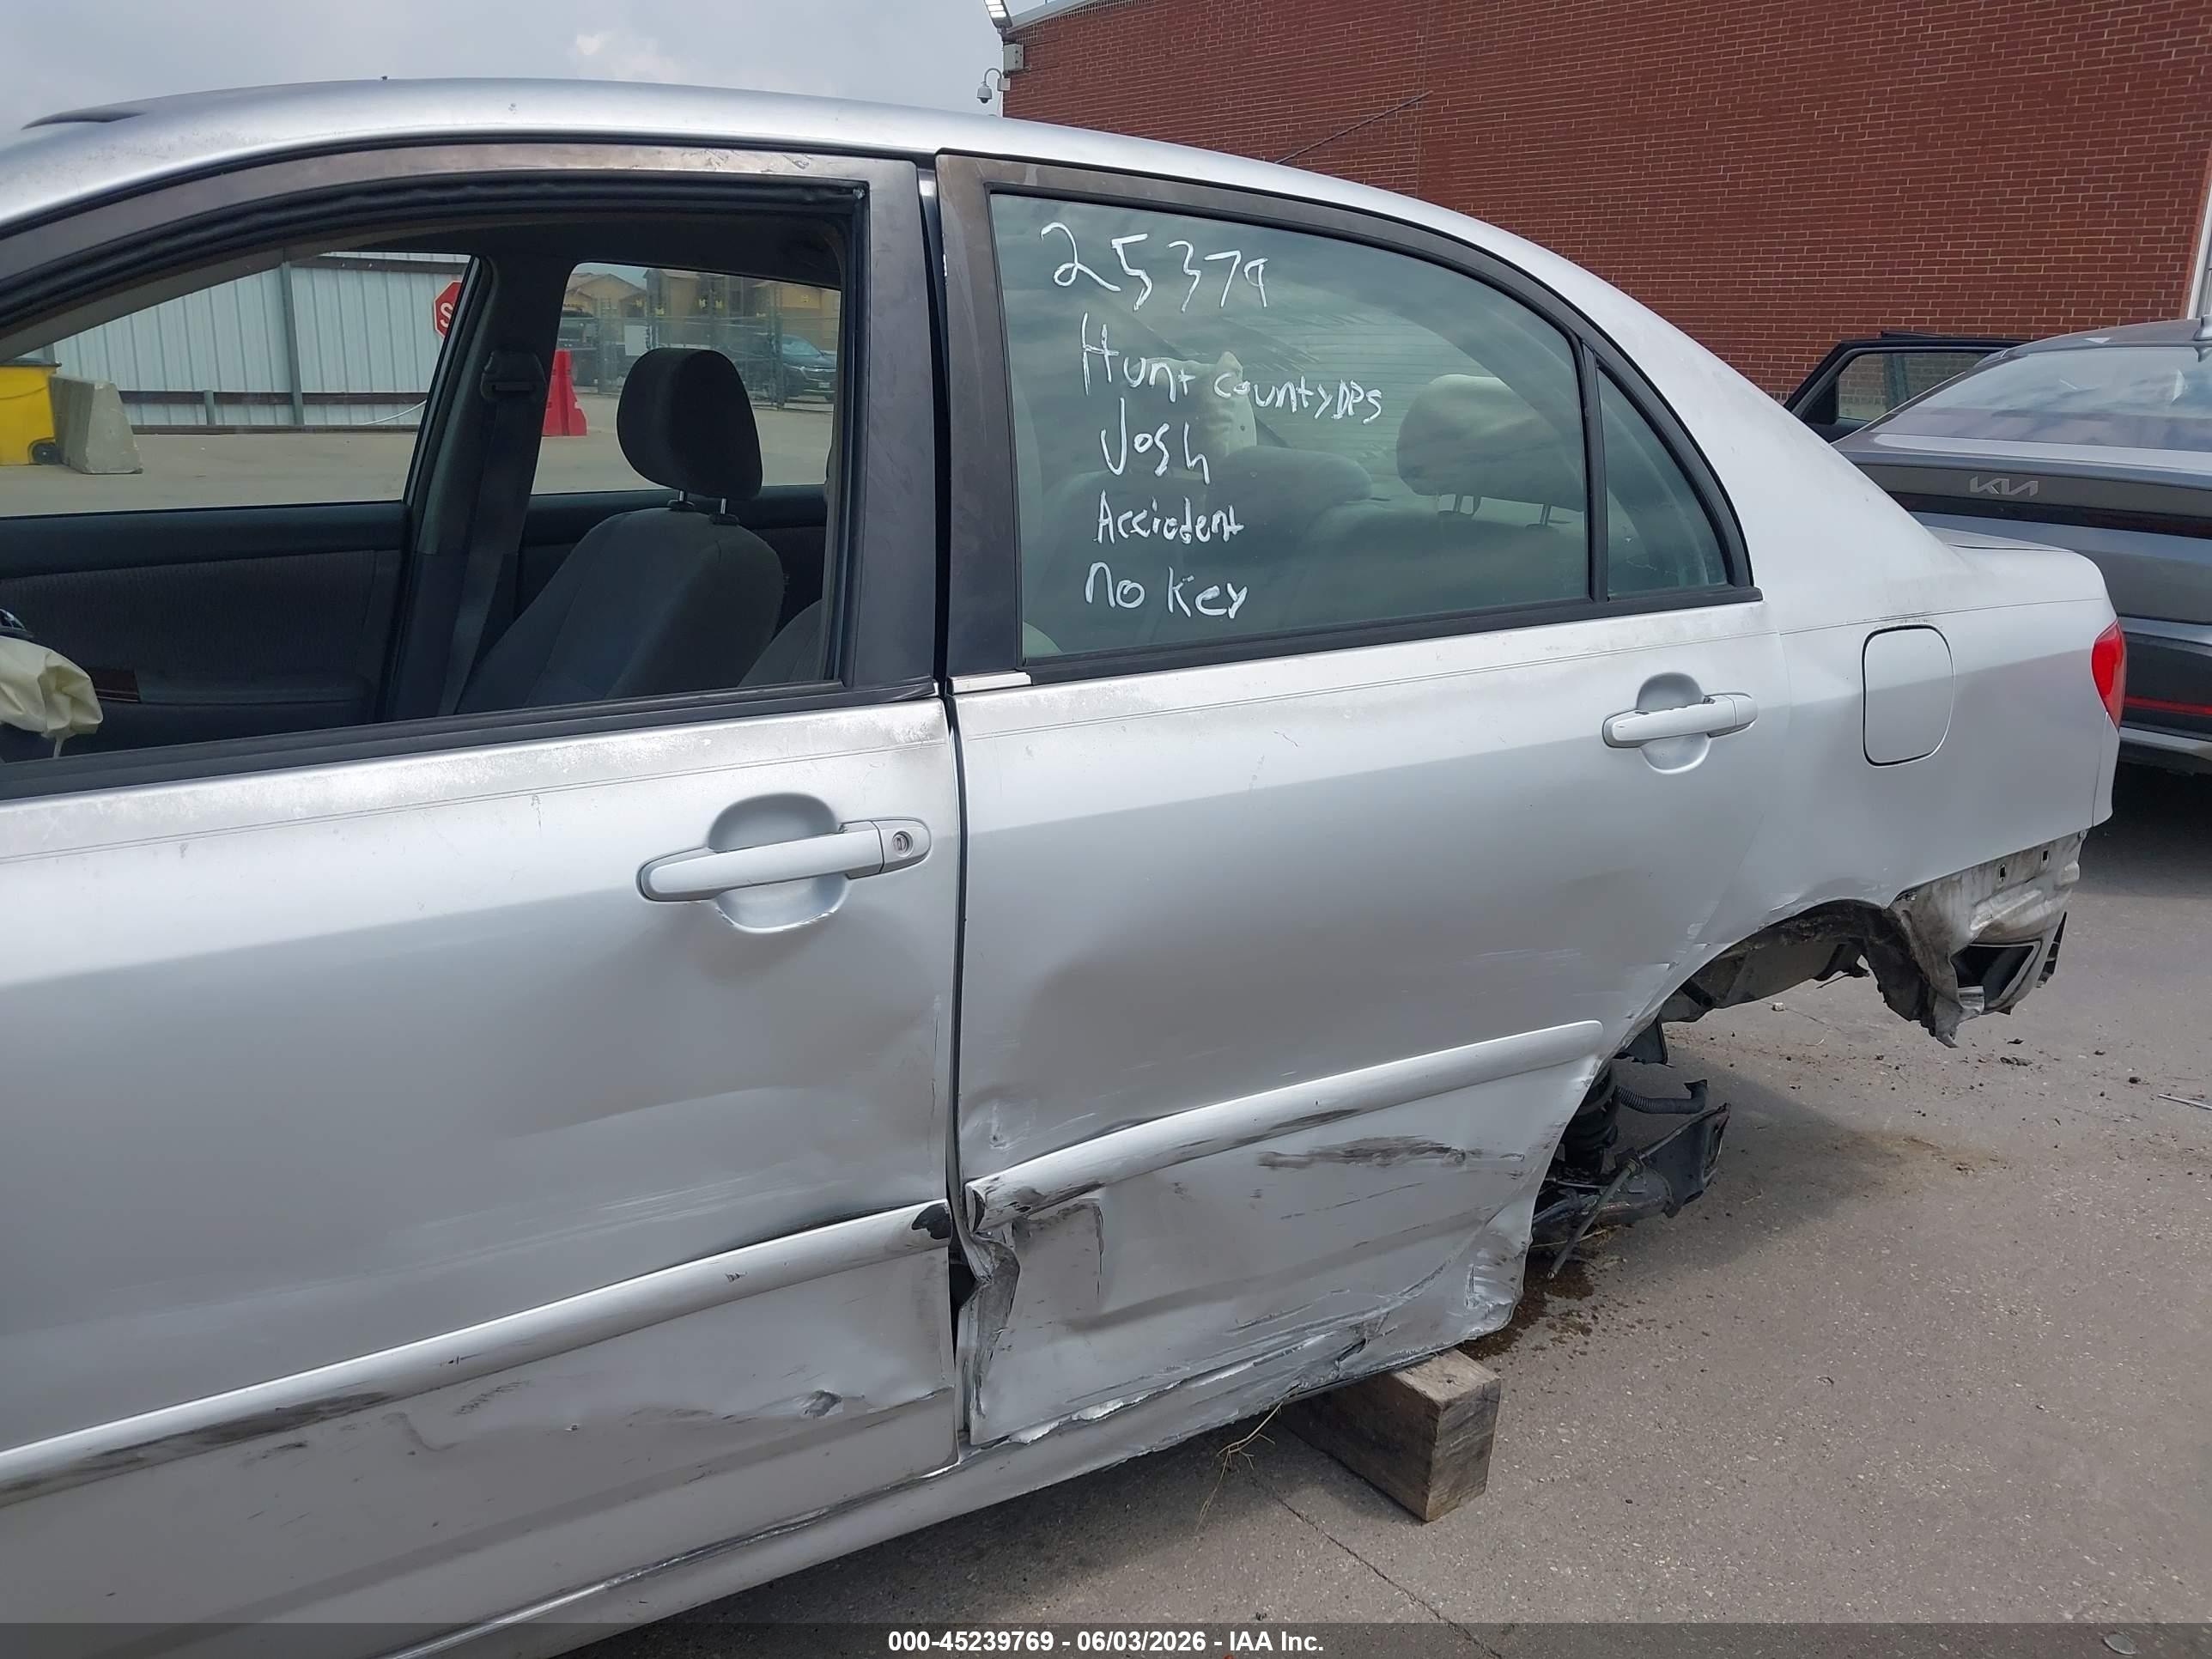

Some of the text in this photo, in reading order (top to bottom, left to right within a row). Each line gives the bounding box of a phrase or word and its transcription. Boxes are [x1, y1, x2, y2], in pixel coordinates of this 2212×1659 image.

[1041, 222, 1268, 312] 25379
[1081, 312, 1196, 403] Hunt
[1100, 397, 1211, 485] Josh
[1093, 489, 1245, 544] Accident
[1970, 476, 2039, 496] KIA
